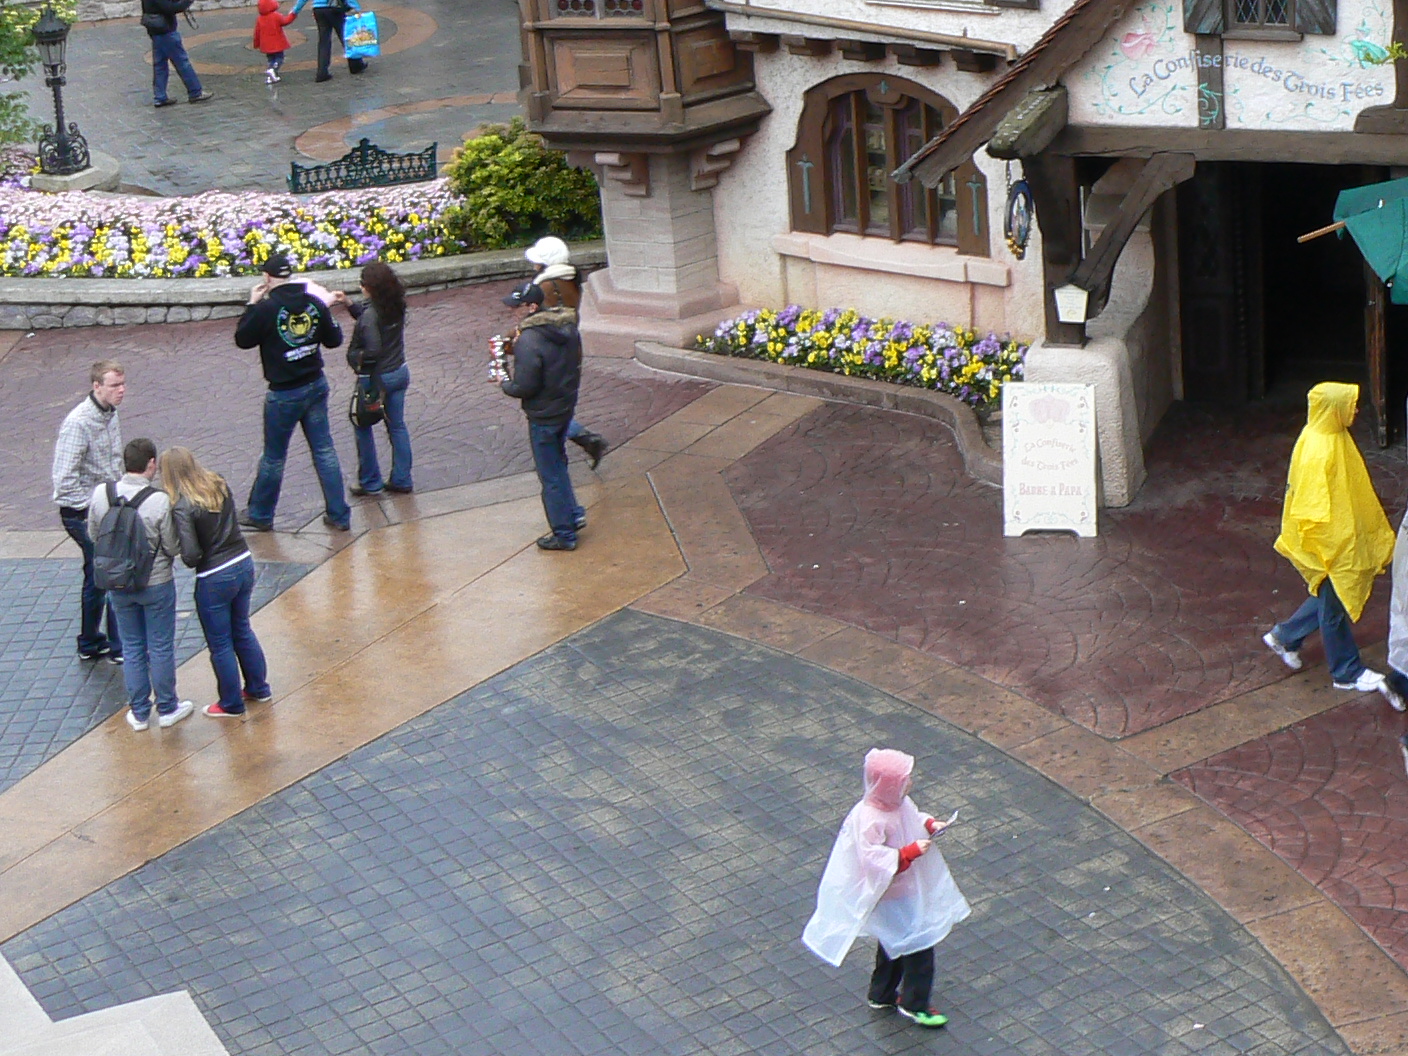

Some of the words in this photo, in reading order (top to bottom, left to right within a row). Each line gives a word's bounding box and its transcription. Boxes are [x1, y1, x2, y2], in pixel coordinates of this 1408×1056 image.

[1129, 73, 1154, 98] La
[1153, 48, 1249, 80] Confiserie
[1249, 56, 1283, 82] des
[1283, 70, 1337, 100] Trois
[1024, 442, 1036, 453] La
[1021, 456, 1035, 467] des
